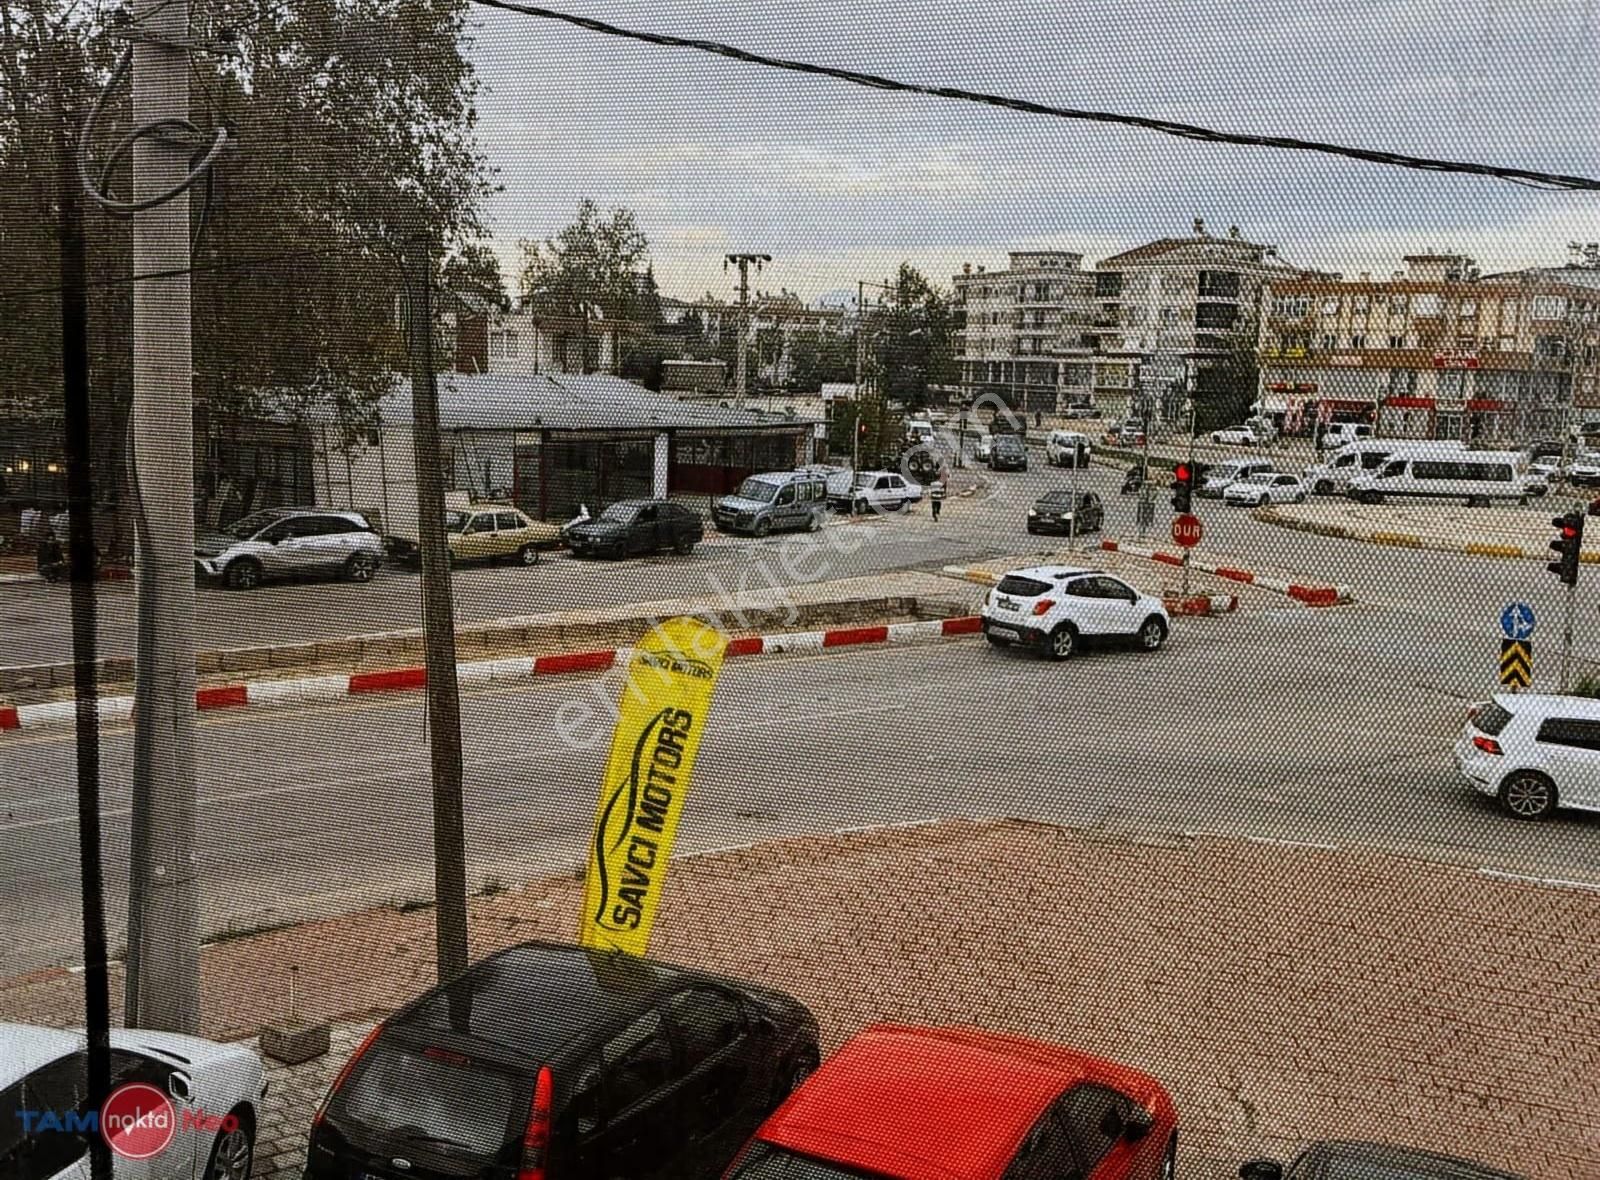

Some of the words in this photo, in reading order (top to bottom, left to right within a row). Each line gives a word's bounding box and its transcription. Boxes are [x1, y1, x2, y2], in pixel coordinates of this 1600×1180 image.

[1174, 523, 1201, 539] DUR
[613, 835, 657, 930] SAVCI
[636, 707, 693, 833] MOTORS
